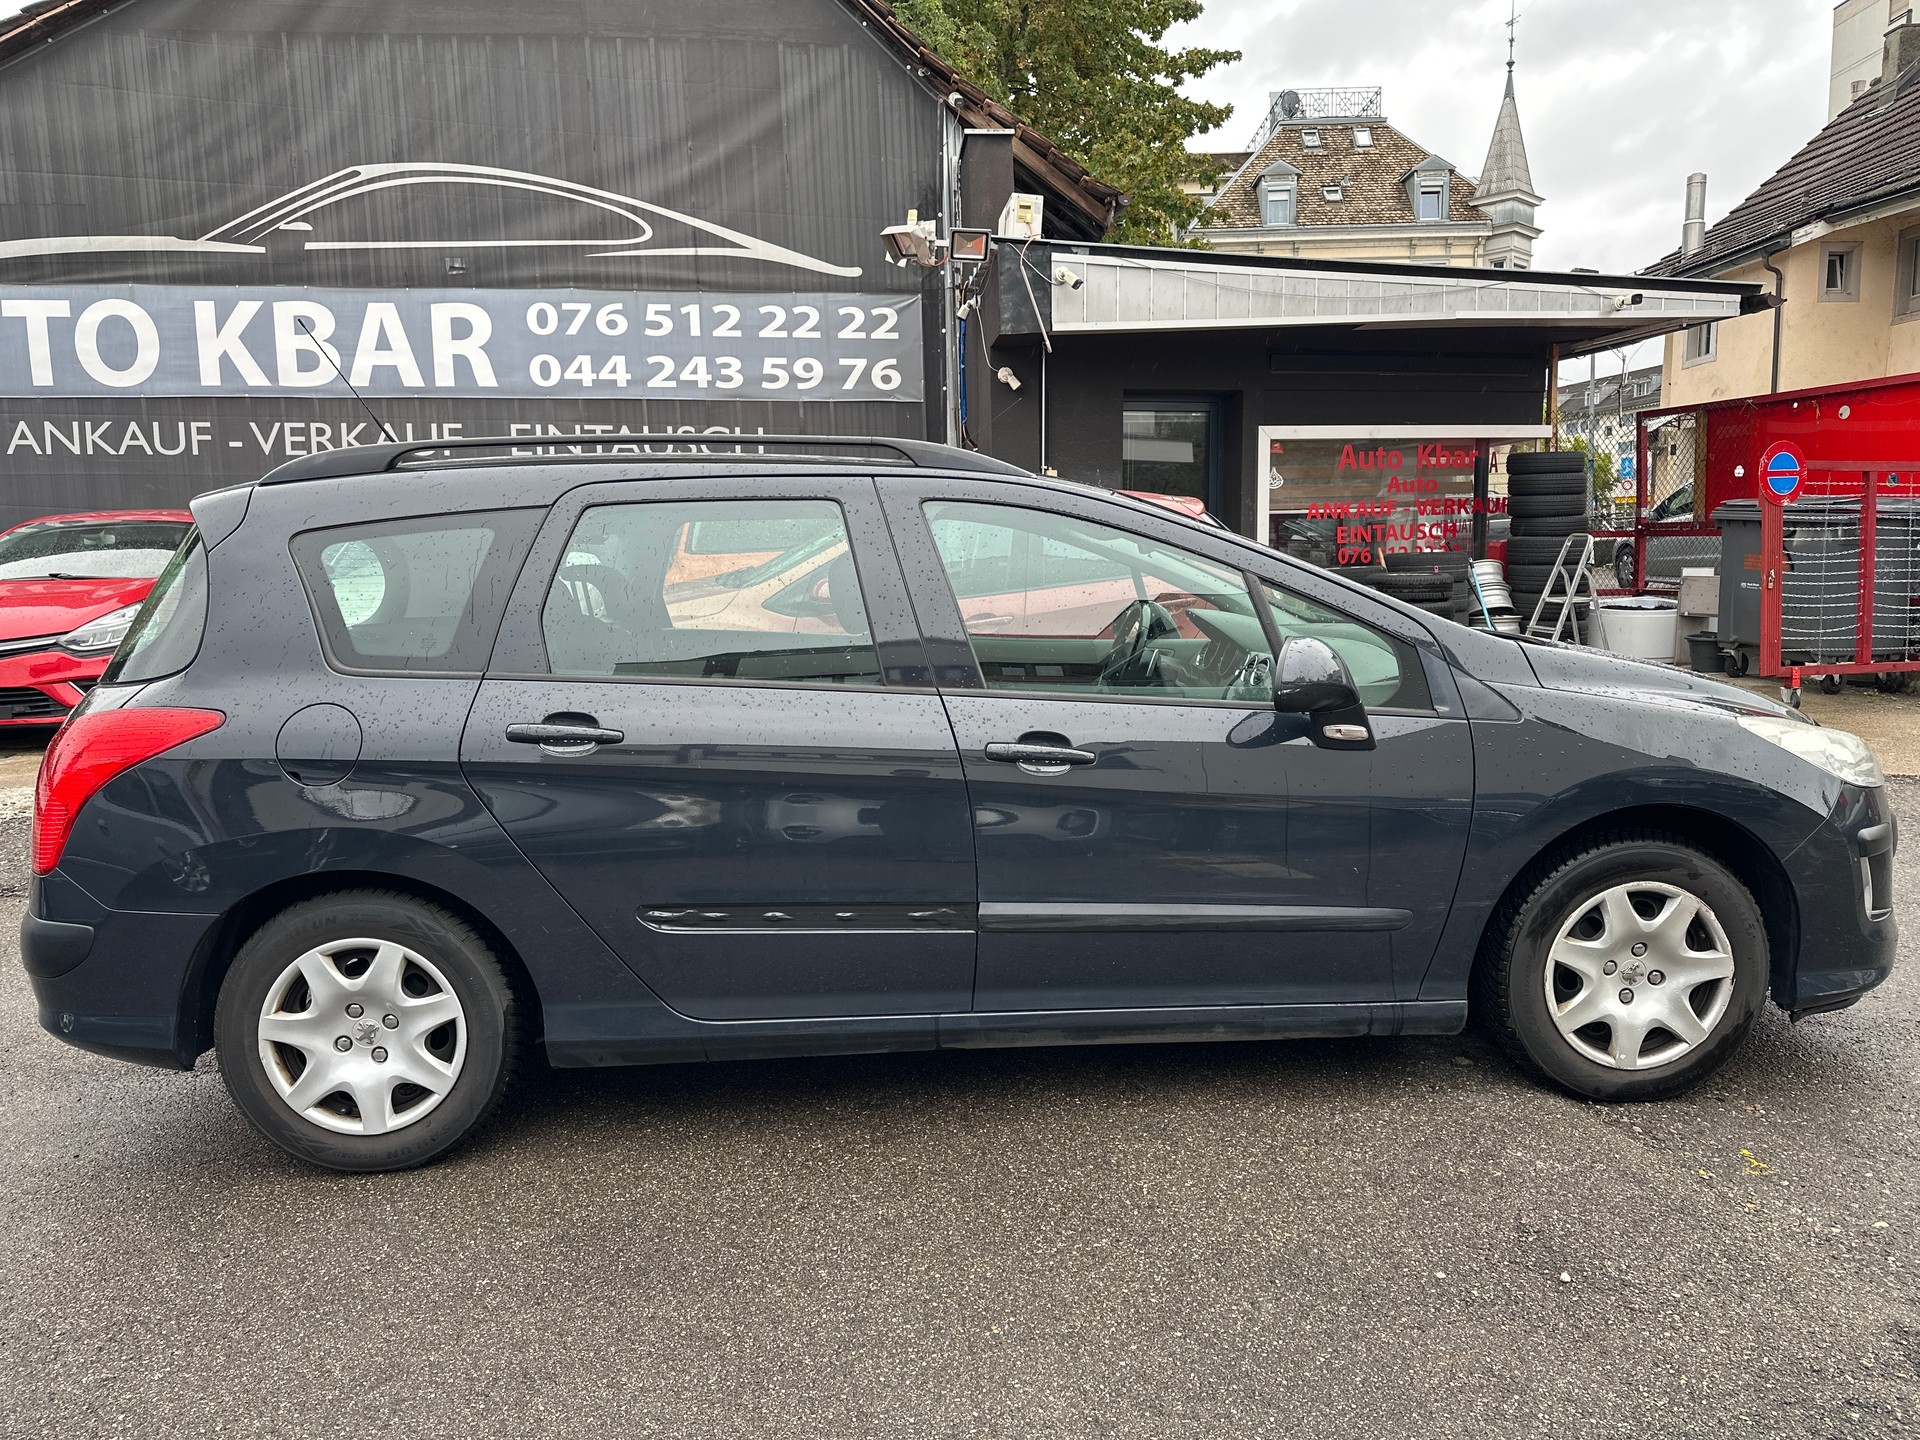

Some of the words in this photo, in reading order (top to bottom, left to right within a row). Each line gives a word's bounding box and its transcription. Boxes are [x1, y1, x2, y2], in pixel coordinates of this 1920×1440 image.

[525, 302, 629, 336] 076
[644, 303, 742, 337] 512
[758, 304, 822, 339] 22
[837, 306, 900, 340] 22
[2, 298, 161, 388] TO
[193, 300, 499, 388] KBAR
[528, 354, 632, 388] 044
[646, 355, 744, 389] 243
[760, 356, 824, 390] 59
[838, 357, 902, 391] 76
[6, 420, 212, 456] ANKAUF
[510, 423, 765, 456] EINTAUSCH
[1338, 444, 1403, 471] Auto
[1416, 443, 1479, 470] Kbar
[1386, 475, 1439, 494] Auto
[1305, 499, 1398, 520] ANKAUF
[1336, 521, 1458, 544] EINTAUSCH
[1337, 547, 1372, 565] 076
